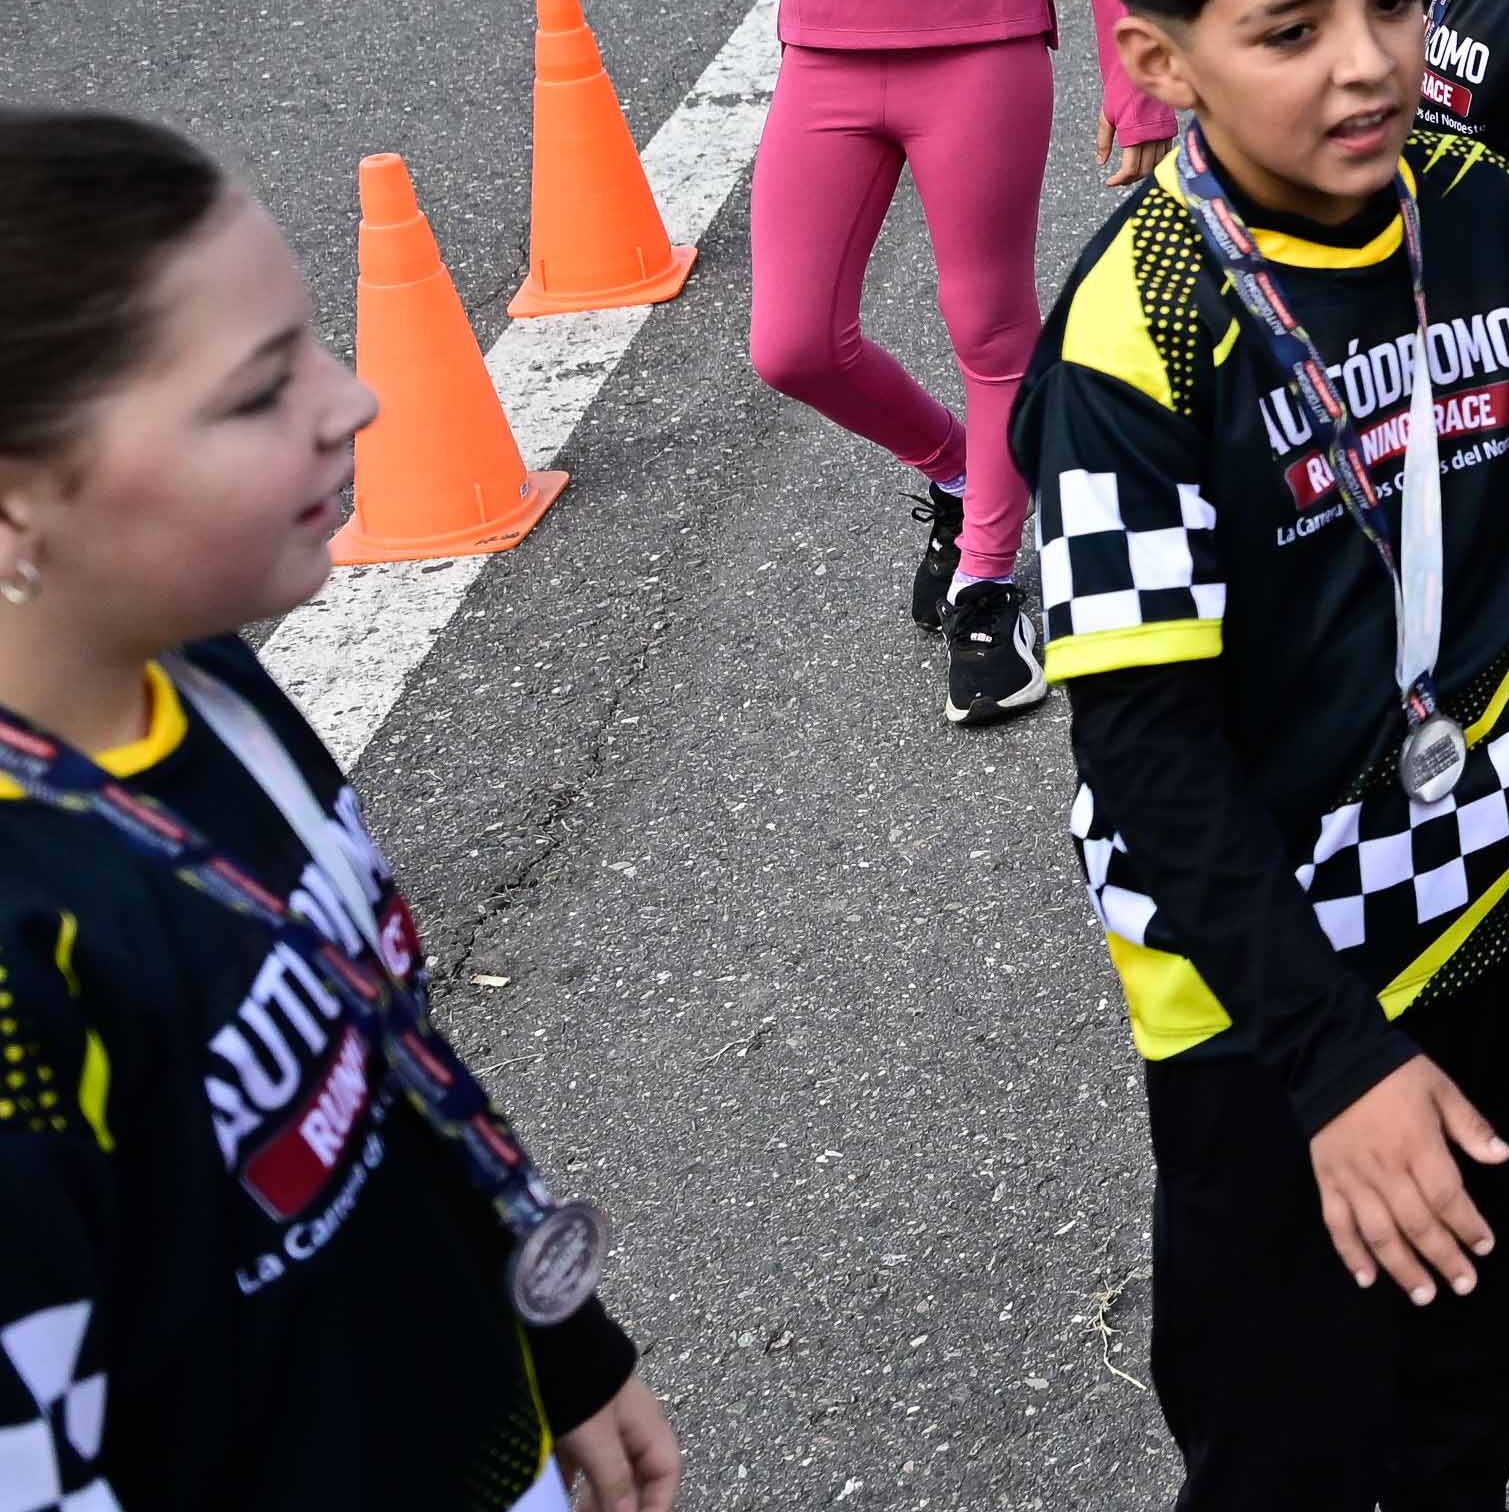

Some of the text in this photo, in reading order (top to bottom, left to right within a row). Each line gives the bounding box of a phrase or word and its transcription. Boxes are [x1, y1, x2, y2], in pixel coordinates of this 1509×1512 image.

[1424, 109, 1439, 124] del
[1451, 449, 1481, 471] del
[1276, 523, 1296, 547] La
